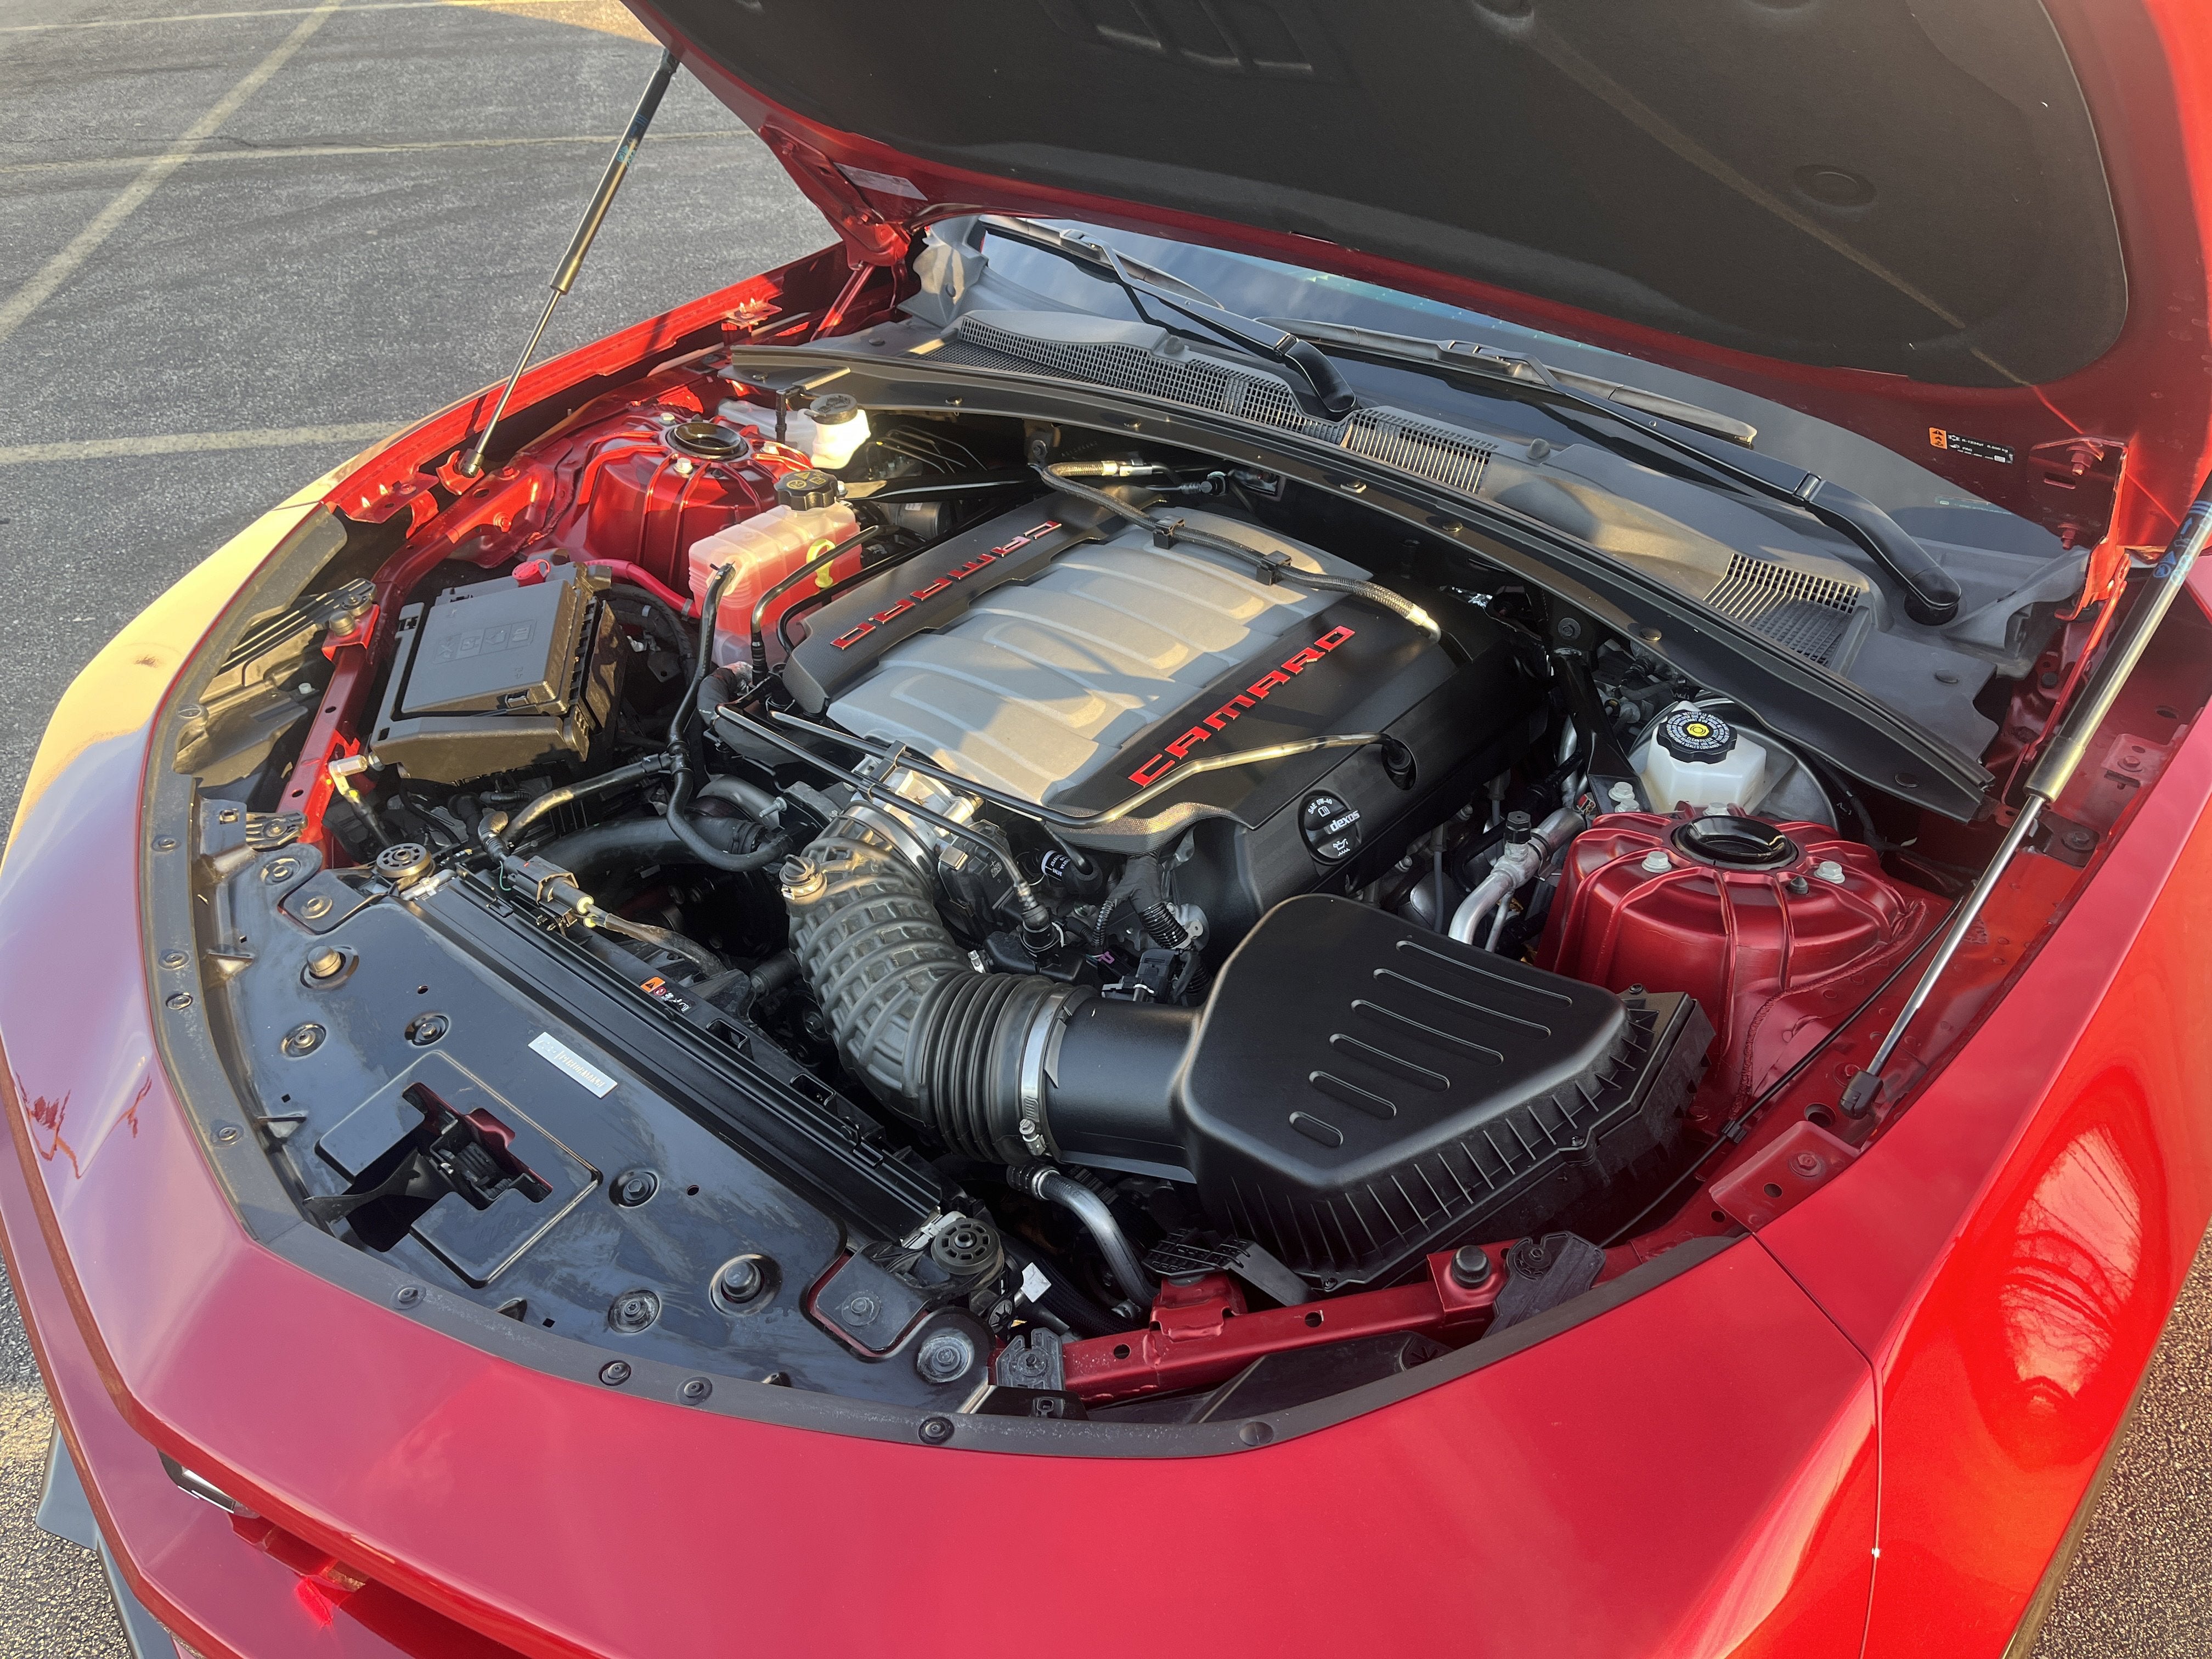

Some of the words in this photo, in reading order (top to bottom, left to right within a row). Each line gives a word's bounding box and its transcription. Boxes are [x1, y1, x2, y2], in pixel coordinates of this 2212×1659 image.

[830, 520, 1062, 650] CAMARO
[1128, 625, 1356, 787] CAMARO
[1307, 802, 1317, 814] SAE
[1329, 810, 1361, 832] dexos
